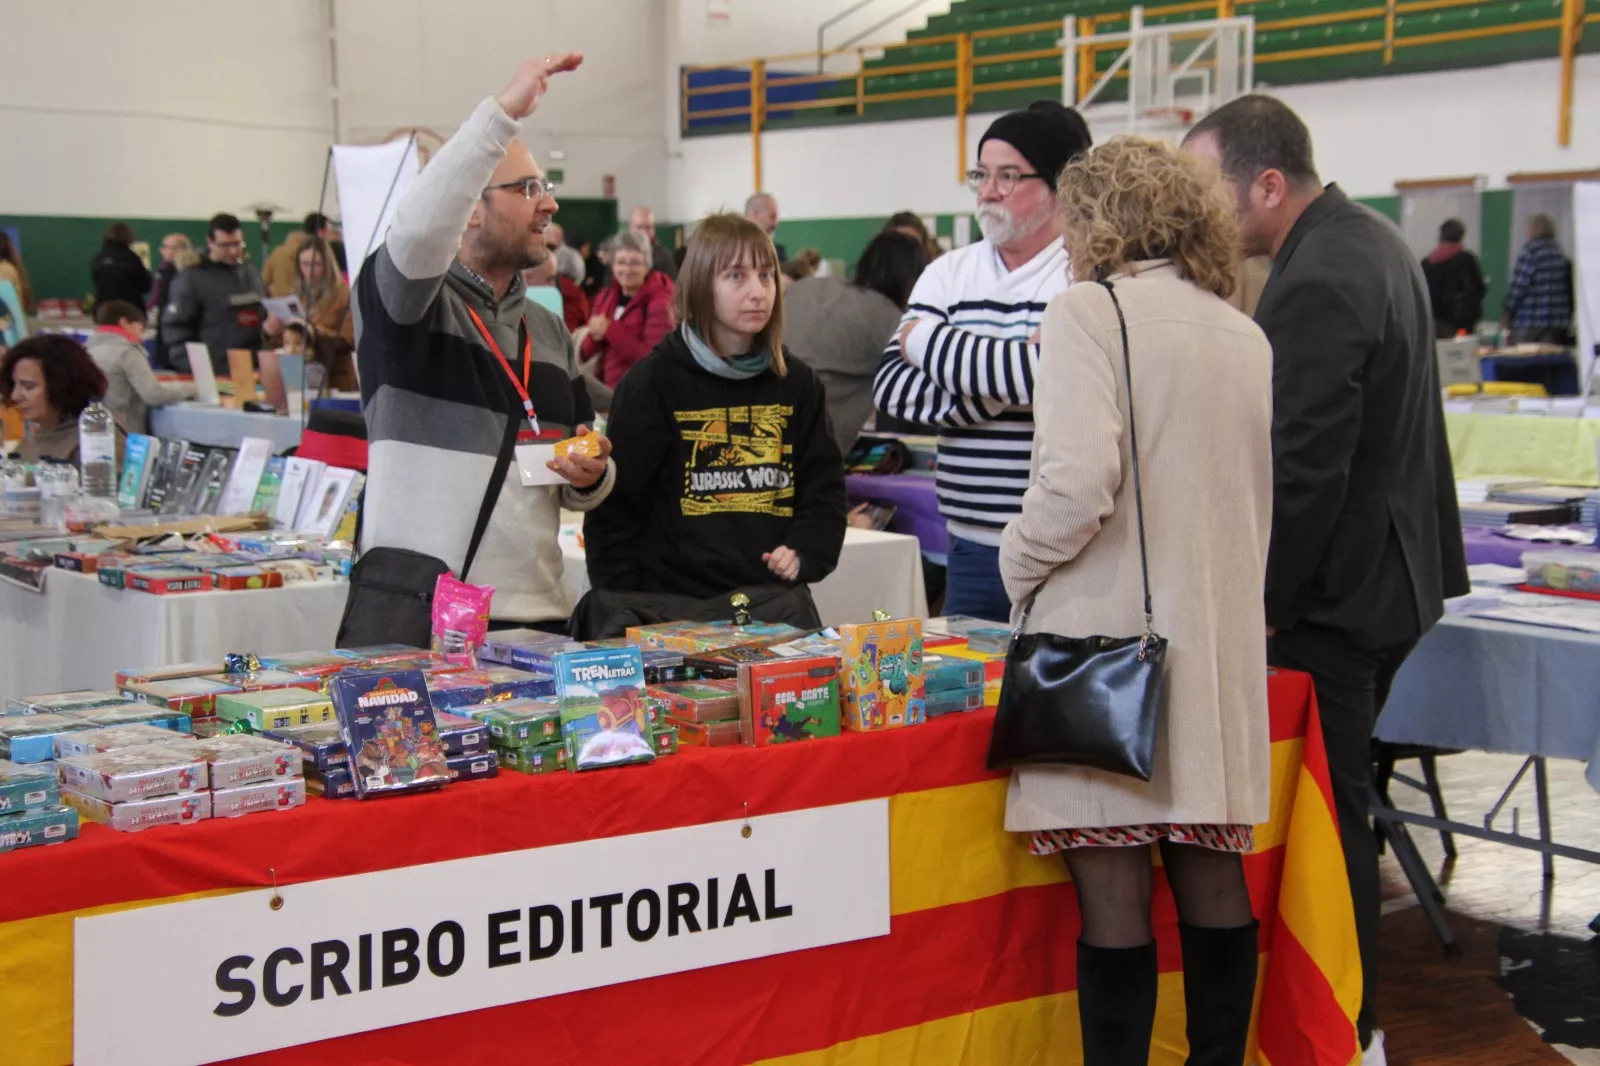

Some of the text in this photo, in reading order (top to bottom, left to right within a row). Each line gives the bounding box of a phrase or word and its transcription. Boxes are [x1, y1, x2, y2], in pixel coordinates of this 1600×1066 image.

[690, 471, 746, 491] JURASSIC
[357, 691, 419, 708] NAVIDAD
[213, 868, 793, 1017] SCRIBO EDITORIAL
